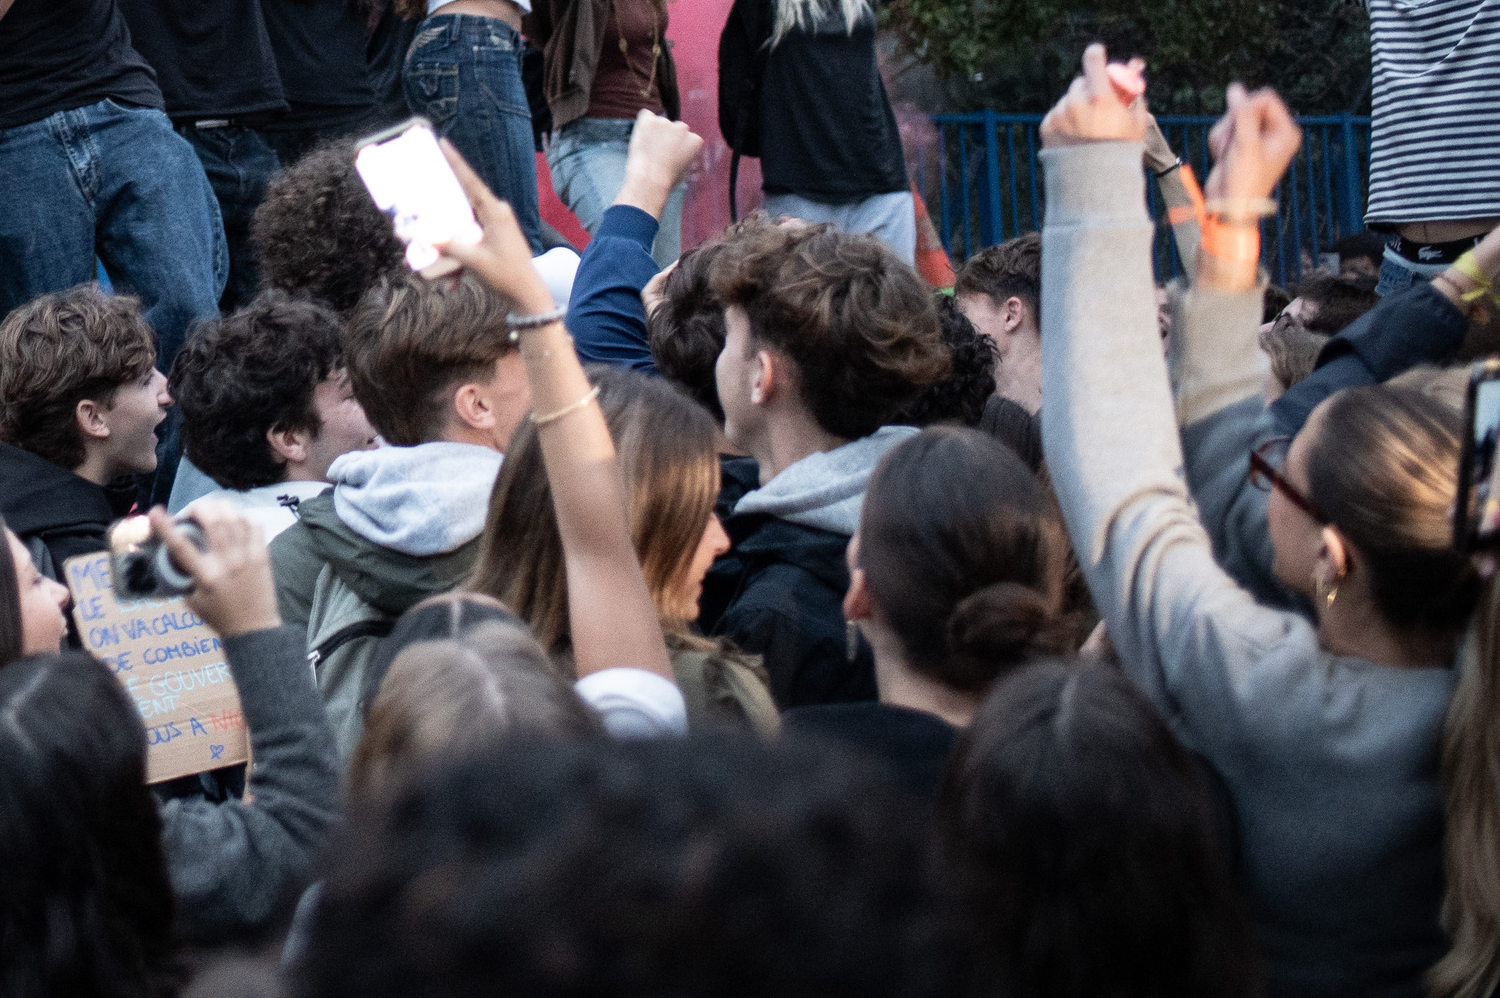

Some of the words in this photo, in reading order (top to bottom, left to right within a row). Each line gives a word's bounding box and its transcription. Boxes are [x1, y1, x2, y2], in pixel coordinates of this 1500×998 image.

[78, 596, 107, 622] LE
[88, 622, 119, 649] ON
[137, 694, 181, 720] ENT
[146, 723, 183, 746] OUS
[190, 716, 208, 737] A
